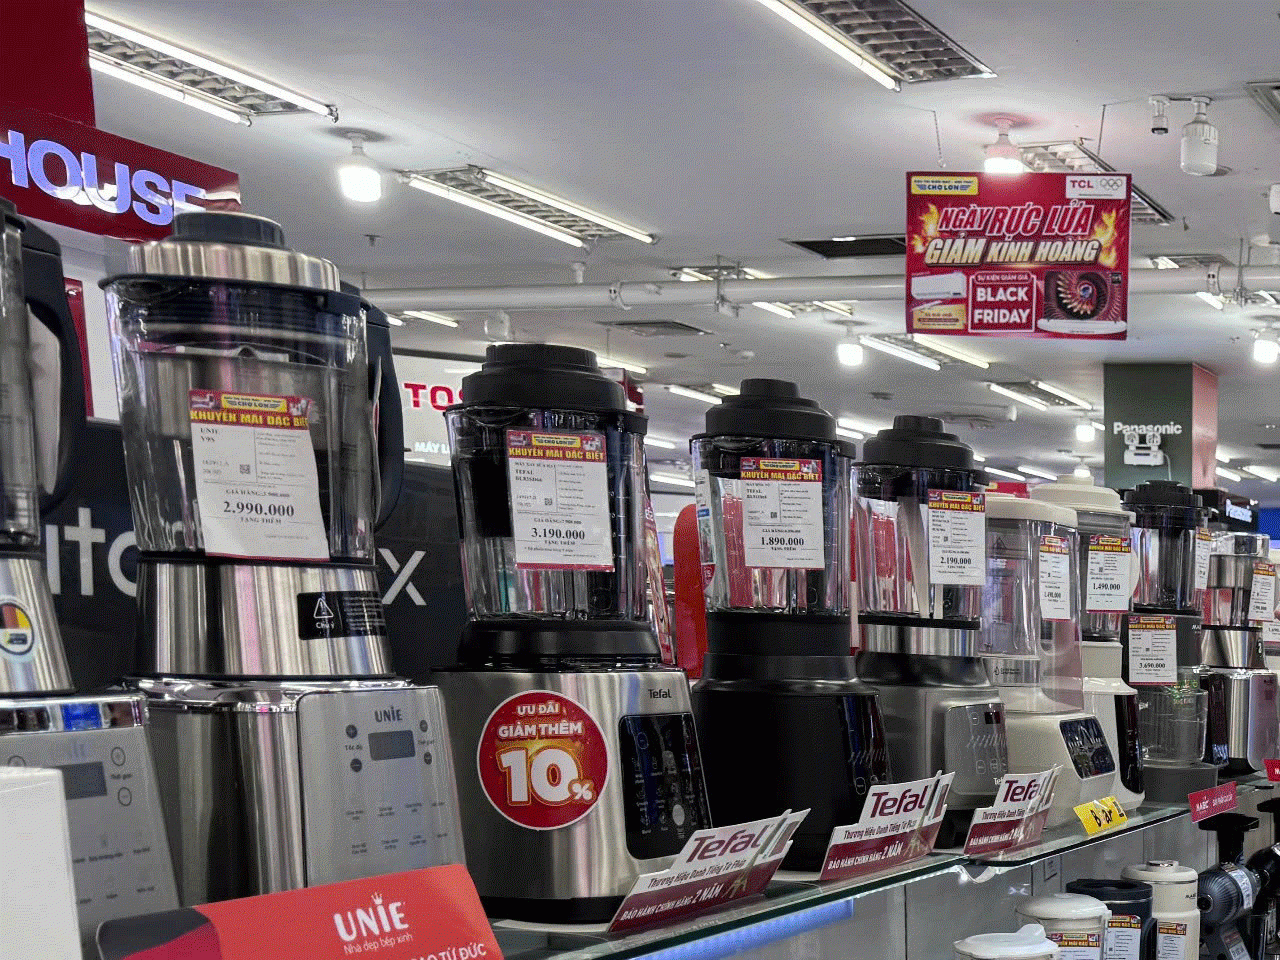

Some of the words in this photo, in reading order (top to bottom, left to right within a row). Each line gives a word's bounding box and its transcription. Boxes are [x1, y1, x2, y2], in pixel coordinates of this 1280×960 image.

[1070, 180, 1094, 189] TCL
[938, 203, 990, 231] NGÀY
[986, 202, 1043, 240] RỰC
[1043, 200, 1095, 236] LỬA
[925, 232, 986, 265] GIẢM
[987, 240, 1034, 263] KINH
[1035, 237, 1100, 262] HOÀNG
[976, 287, 1029, 301] BLACK
[974, 309, 1030, 323] FRIDAY
[1113, 422, 1182, 435] Panasonic
[224, 501, 294, 517] 2.990.000
[531, 527, 585, 540] 3.190.000
[761, 537, 804, 546] 1.890.000
[940, 557, 972, 565] 2.190.000
[648, 689, 672, 699] Tefal
[375, 706, 403, 723] UNIE
[517, 703, 536, 715] ƯU
[538, 702, 559, 714] ĐÃI
[498, 722, 536, 737] GIẢM
[539, 720, 583, 736] THÊM
[870, 785, 929, 818] Tefal
[686, 825, 769, 863] Tefal
[621, 909, 637, 921] BẢO
[638, 905, 656, 917] HÀNH
[656, 901, 675, 912] CHÍNH
[700, 883, 724, 902] NĂM
[334, 901, 409, 942] UNIE
[459, 942, 487, 960] ĐỨC
